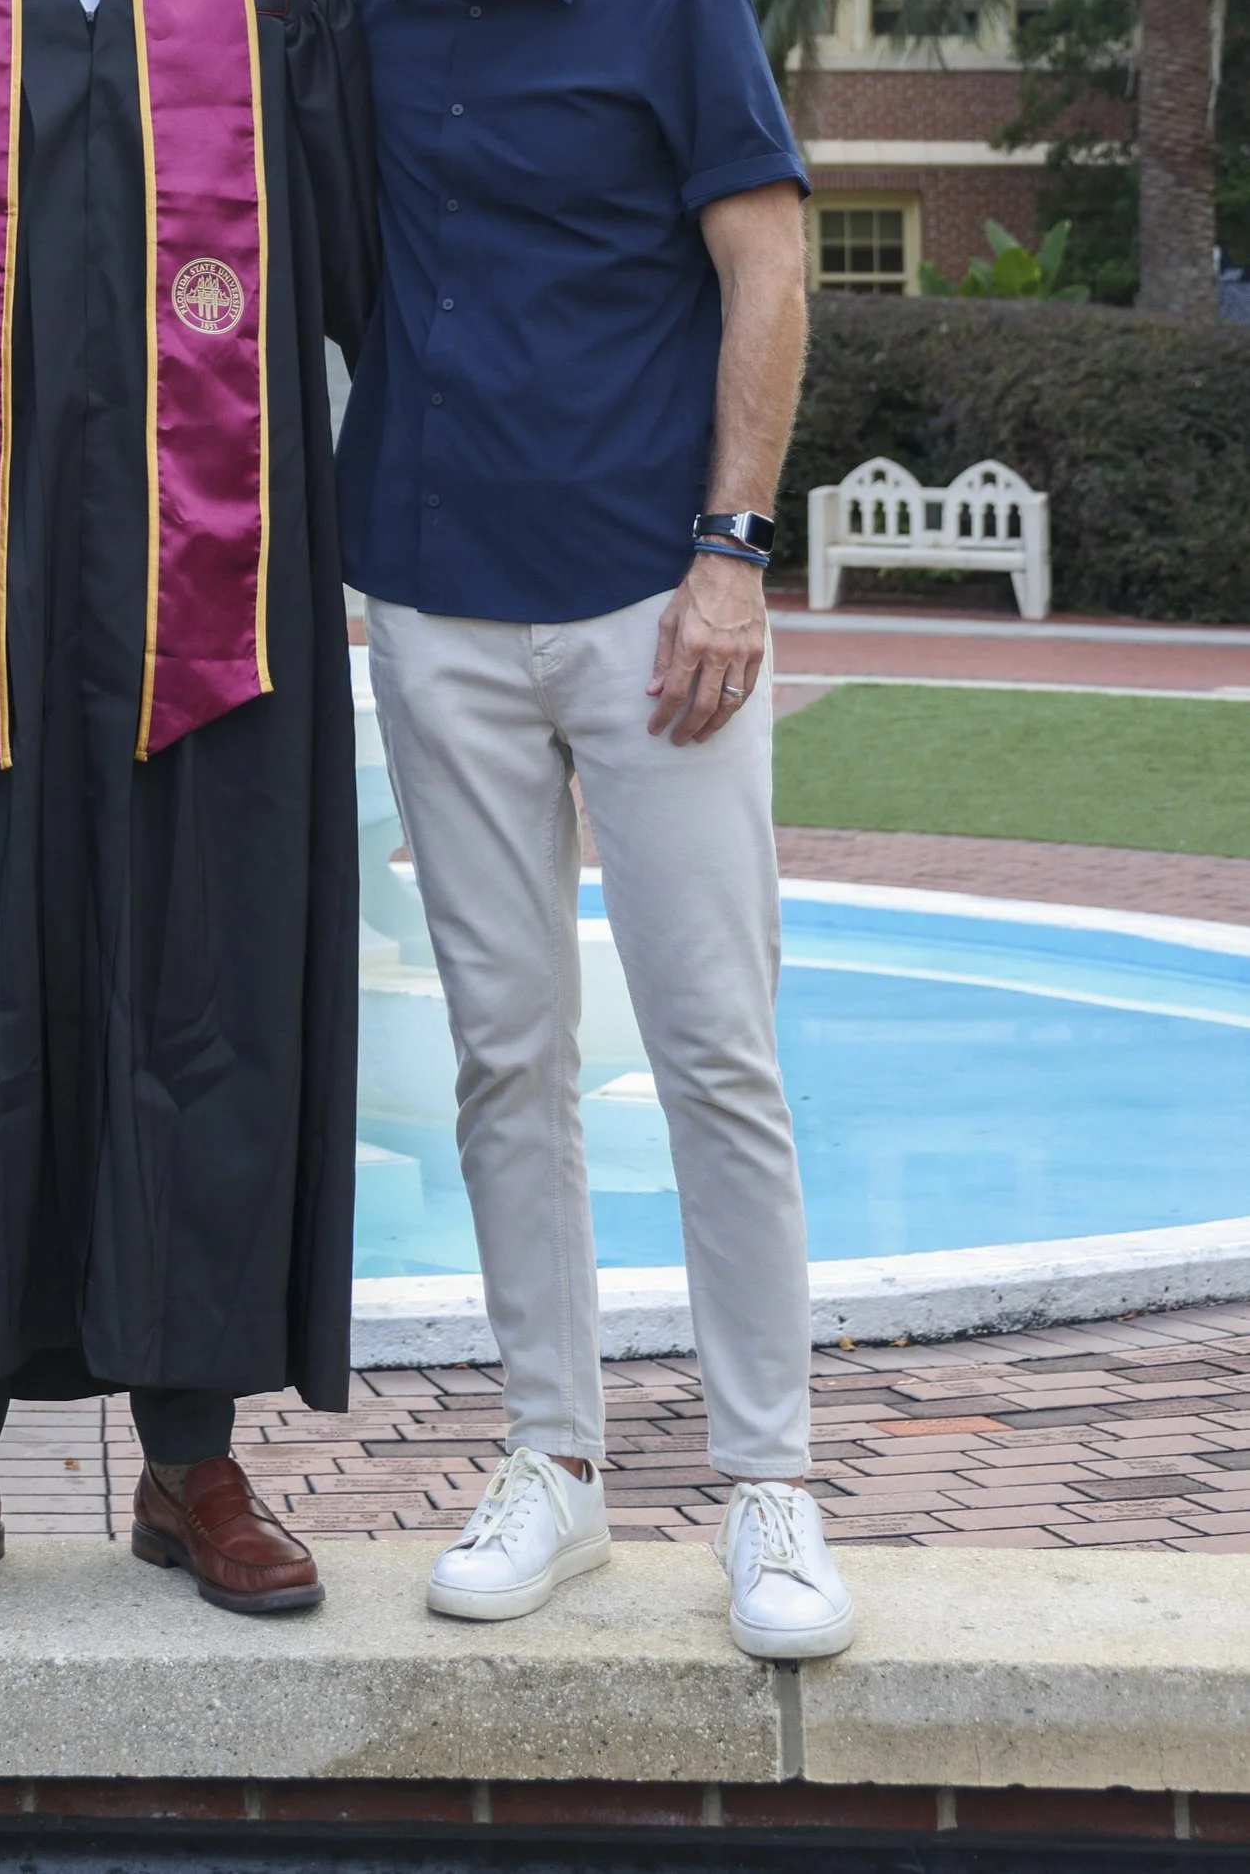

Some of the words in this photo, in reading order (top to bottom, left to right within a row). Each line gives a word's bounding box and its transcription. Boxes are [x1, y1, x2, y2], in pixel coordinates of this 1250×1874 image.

[176, 275, 190, 315] FLORIDA
[190, 263, 216, 275] STATE
[219, 268, 240, 320] UNIVERSITY
[200, 321, 219, 330] 1851
